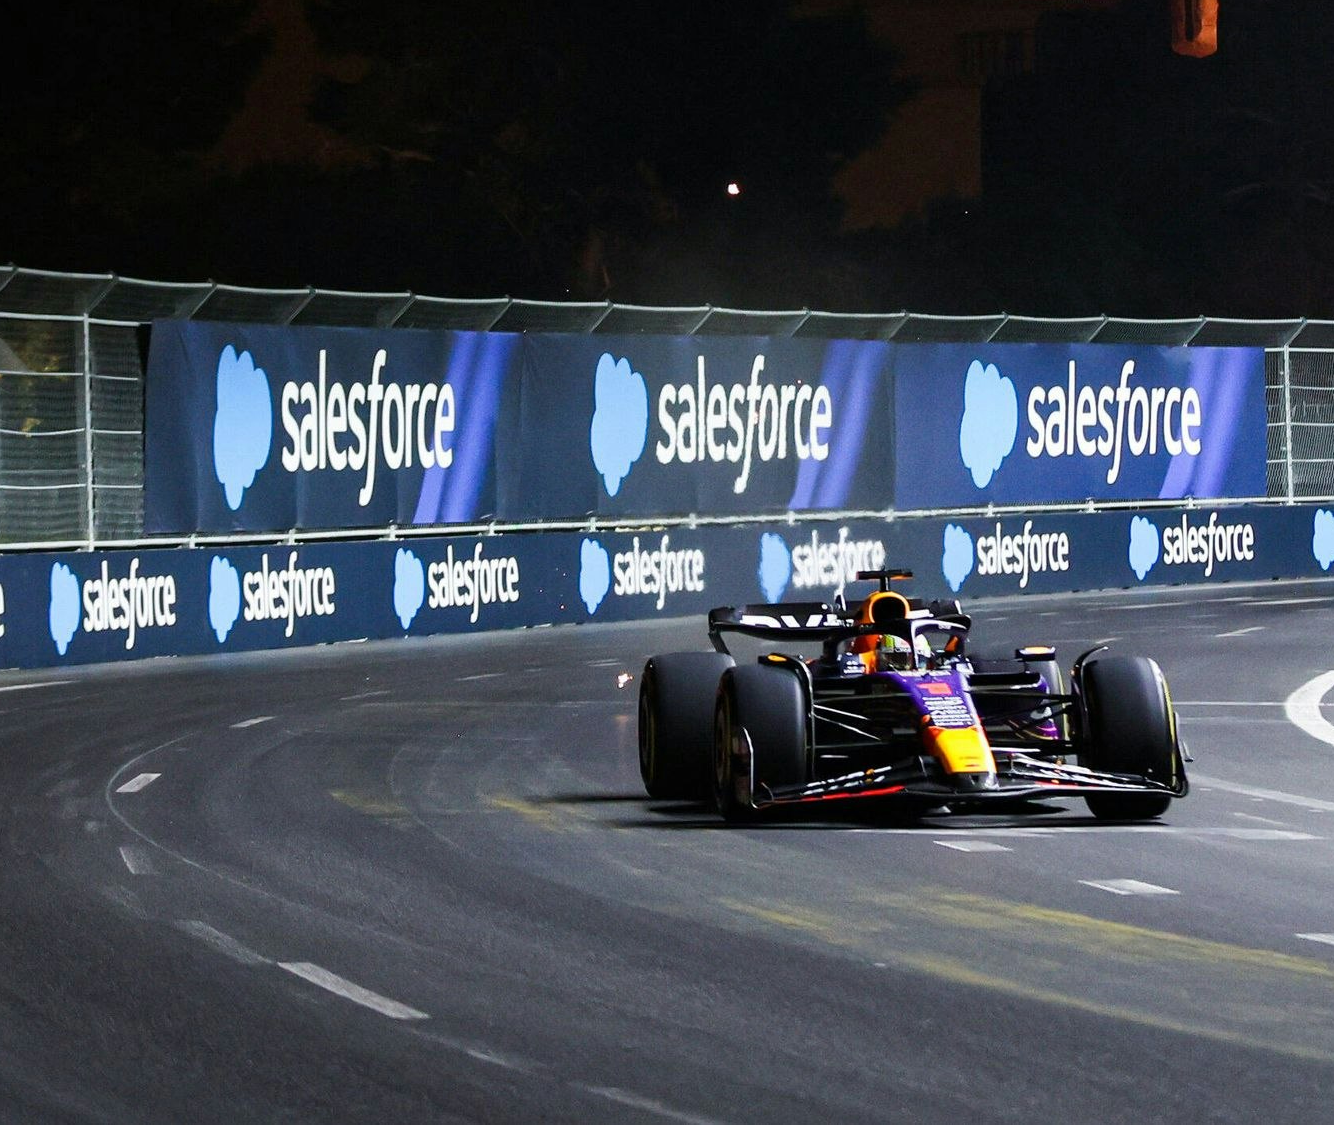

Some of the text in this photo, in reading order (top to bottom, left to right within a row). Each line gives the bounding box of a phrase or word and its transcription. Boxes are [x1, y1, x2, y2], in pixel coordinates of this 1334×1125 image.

[281, 349, 455, 507] salesforce
[656, 355, 833, 494] salesforce
[1026, 360, 1201, 485] salesforce
[428, 543, 519, 623] salesforce
[614, 535, 705, 610] salesforce
[791, 526, 886, 595] salesforce
[977, 520, 1069, 588] salesforce
[1163, 512, 1254, 576] salesforce
[83, 558, 177, 650] salesforce
[243, 551, 336, 638] salesforce
